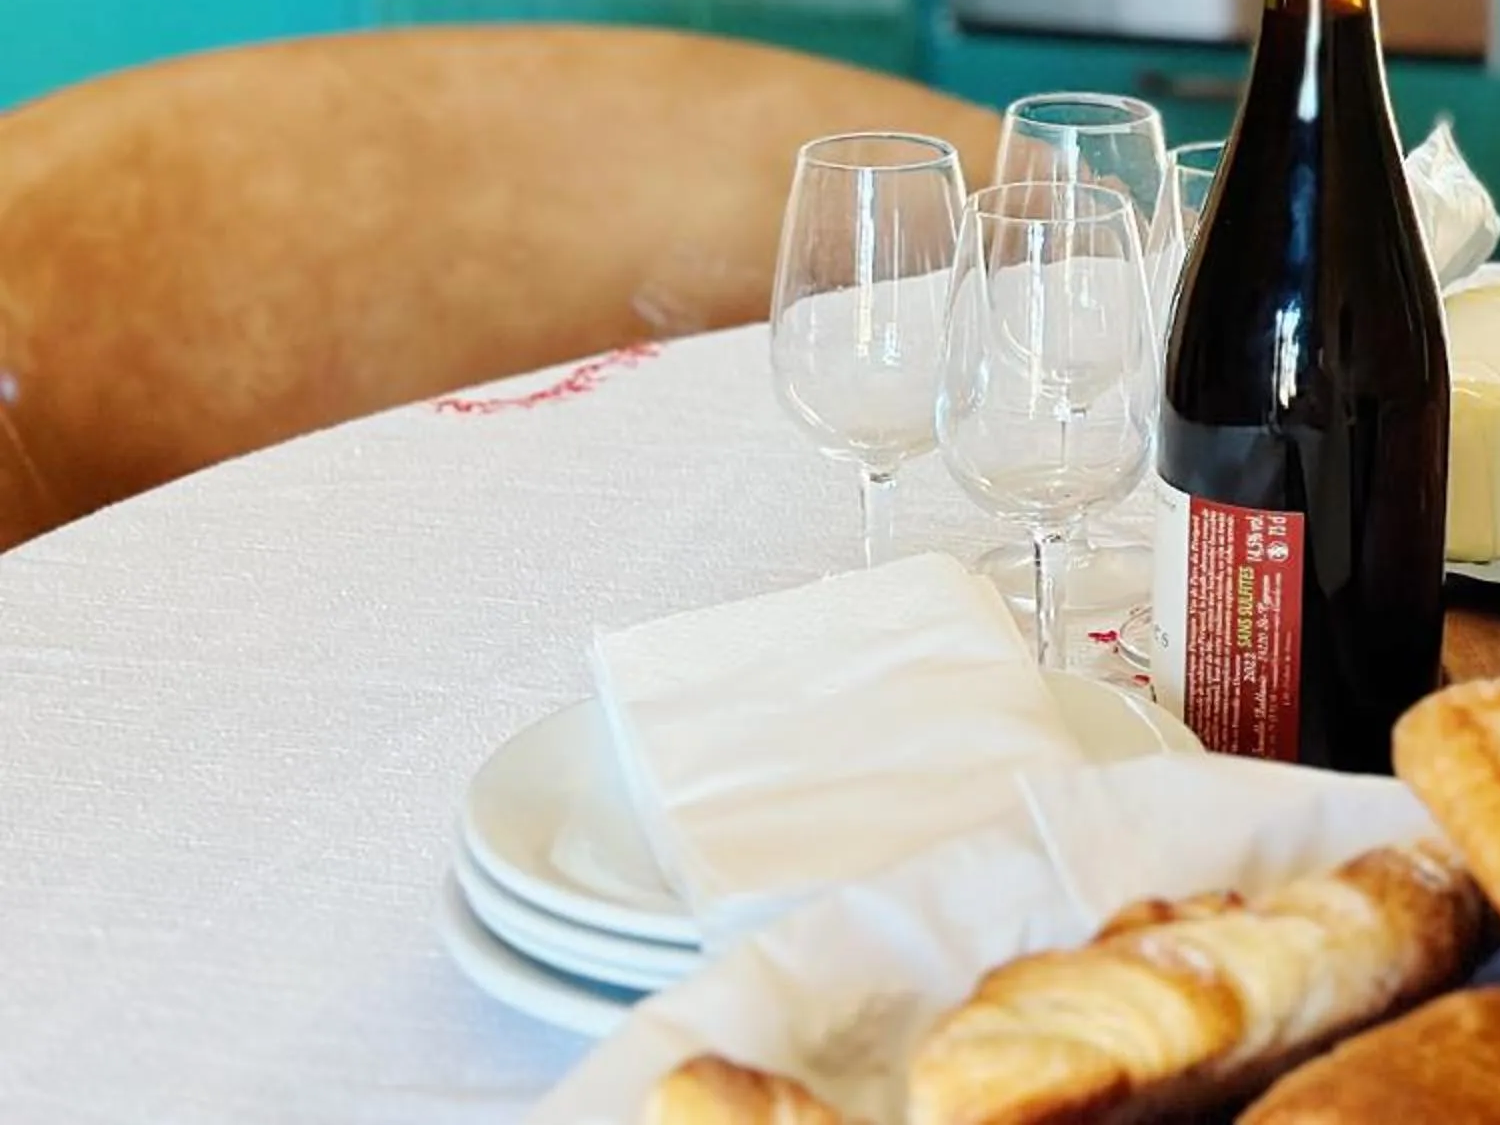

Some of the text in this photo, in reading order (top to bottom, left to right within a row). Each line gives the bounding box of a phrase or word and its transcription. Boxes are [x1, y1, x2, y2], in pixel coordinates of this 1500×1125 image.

[1237, 565, 1255, 648] SANS SULFITES
[1243, 652, 1257, 682] 2022
